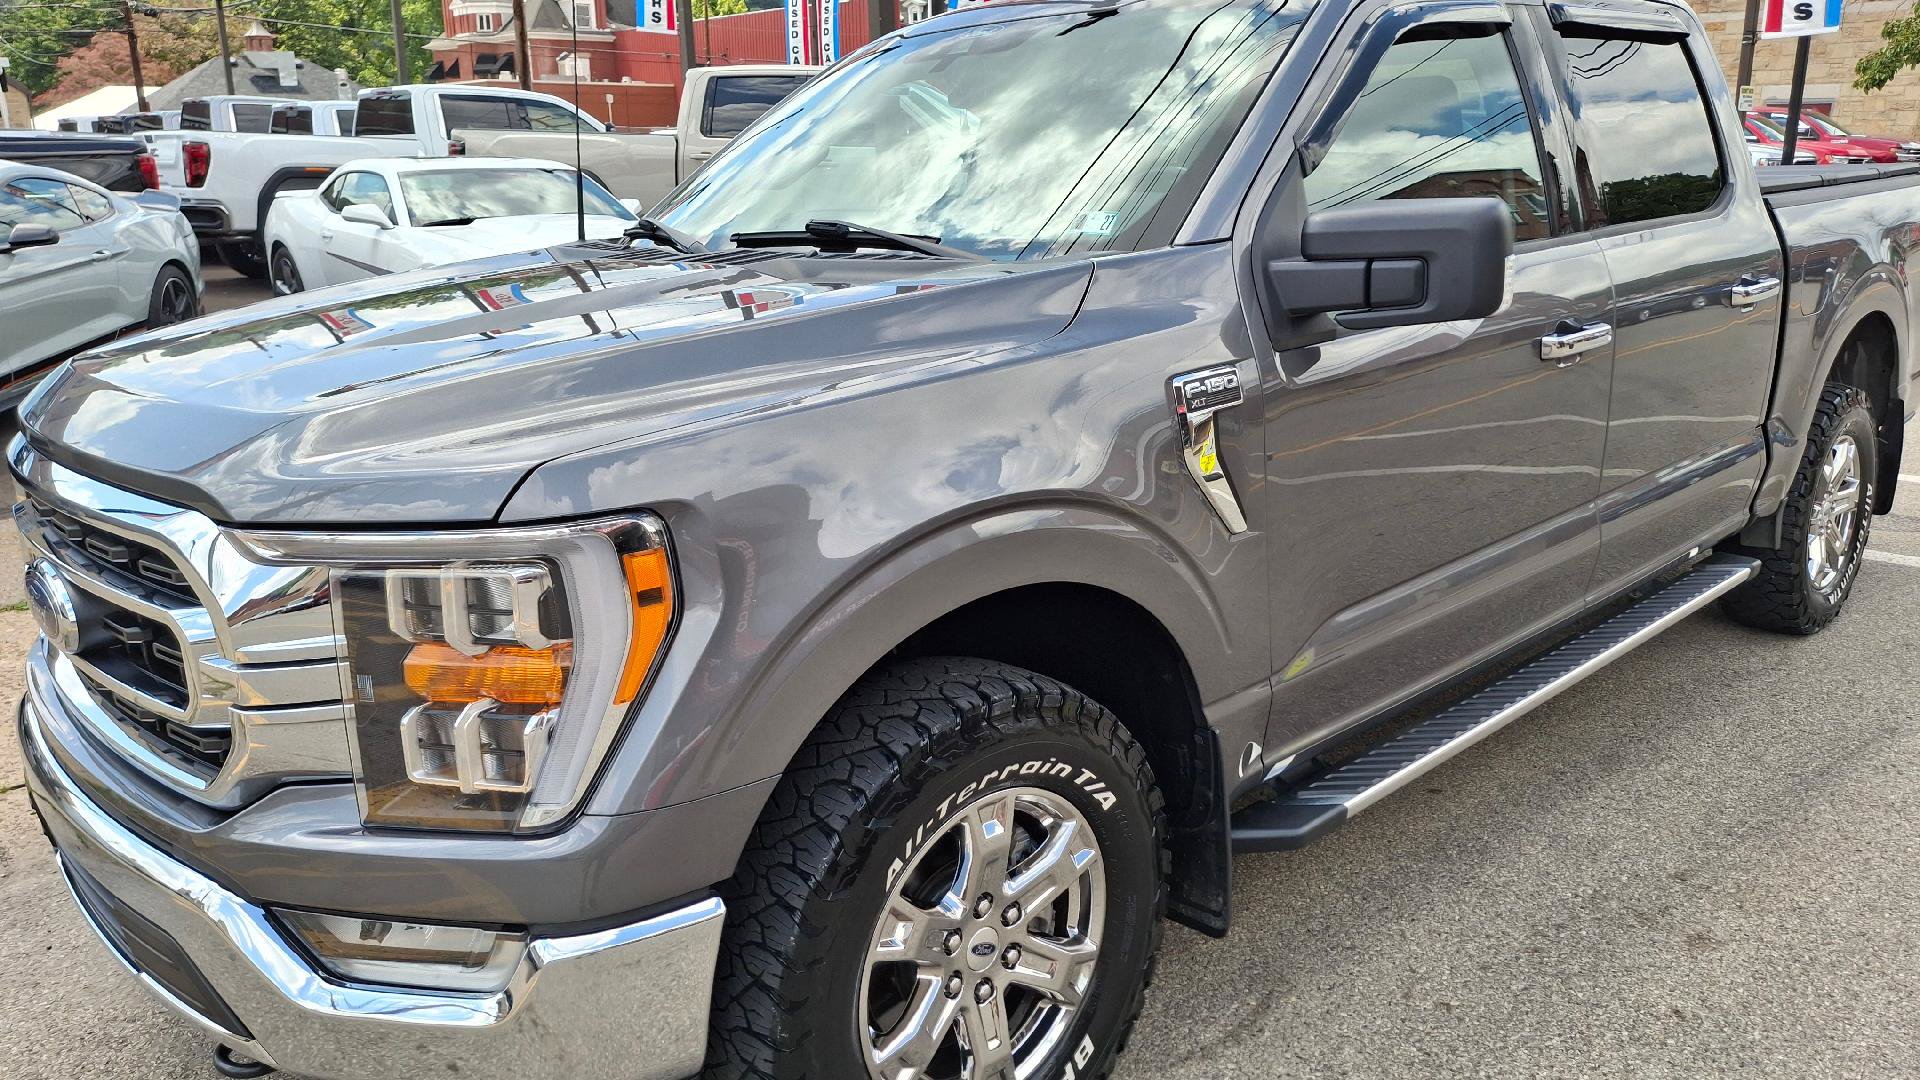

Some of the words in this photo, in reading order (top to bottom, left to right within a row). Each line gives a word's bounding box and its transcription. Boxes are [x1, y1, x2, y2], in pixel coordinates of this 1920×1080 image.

[651, 0, 662, 24] RS
[791, 0, 799, 38] USED
[1793, 2, 1813, 21] S
[823, 44, 831, 66] CA
[1100, 214, 1115, 231] 27
[1184, 374, 1239, 399] F-150
[1191, 397, 1207, 409] XLT
[885, 757, 1073, 893] All-Terrain
[1073, 767, 1117, 811] T/A
